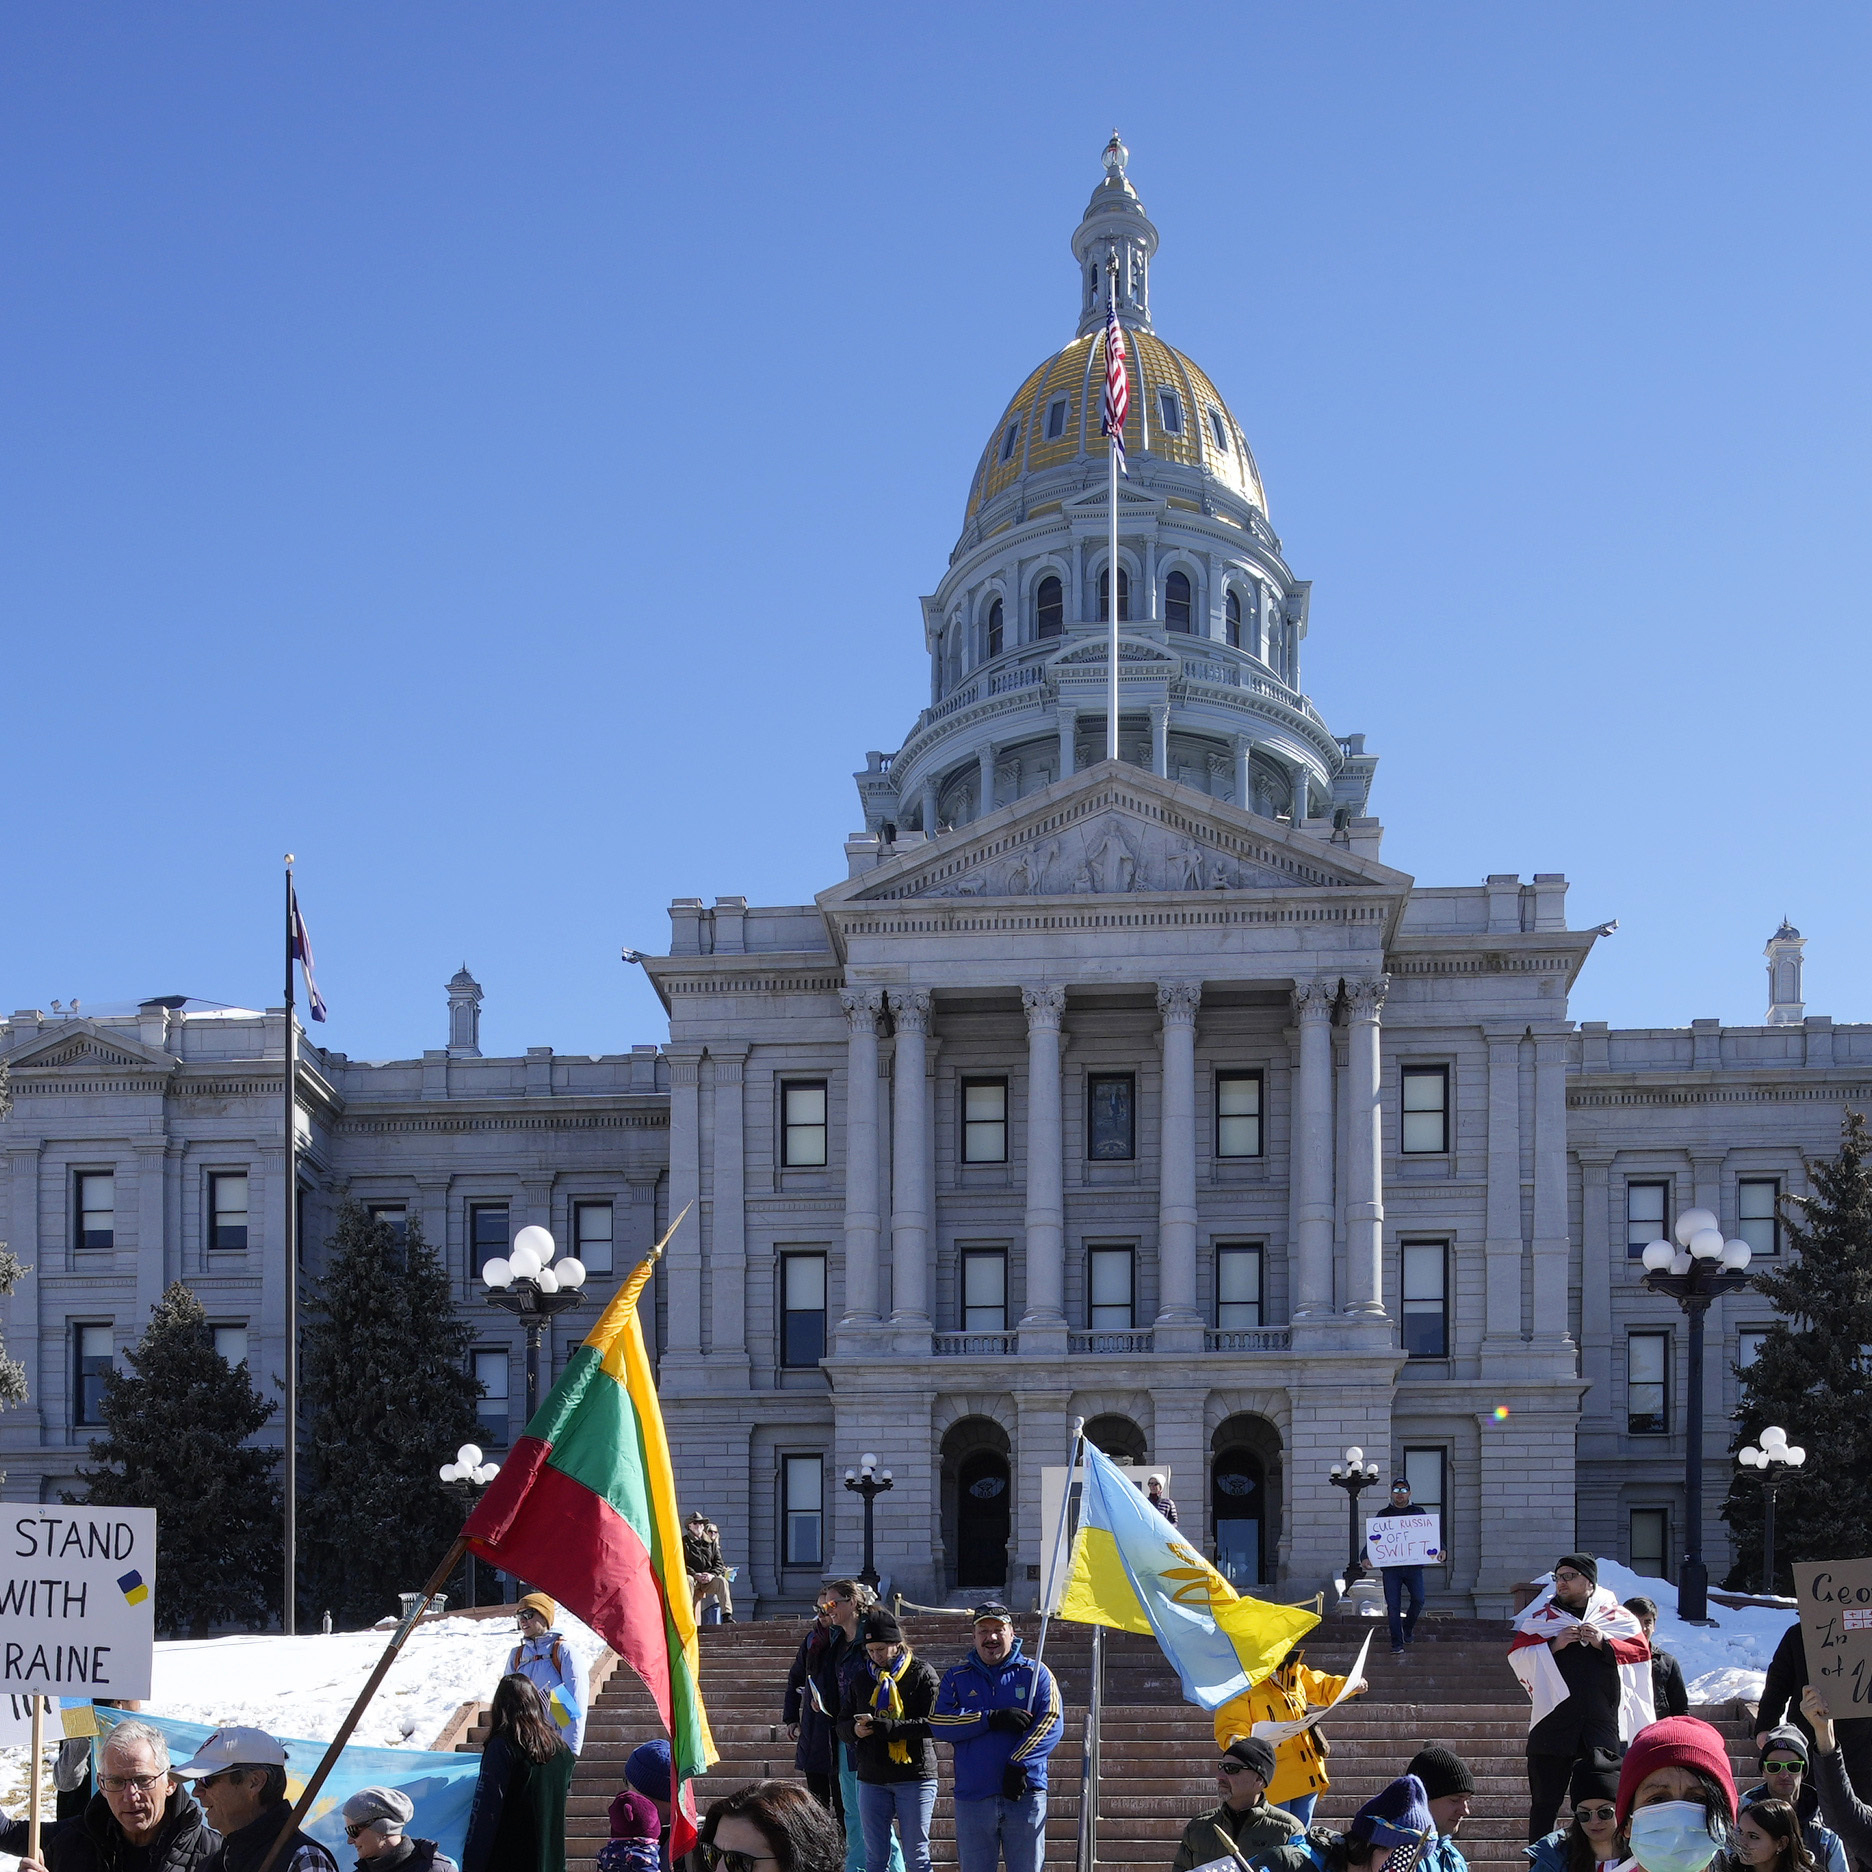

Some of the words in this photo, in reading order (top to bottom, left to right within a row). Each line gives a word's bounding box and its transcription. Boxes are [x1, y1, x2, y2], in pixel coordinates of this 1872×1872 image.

[1400, 1518, 1433, 1529] RUSSIA
[15, 1518, 135, 1561] STAND
[1386, 1531, 1409, 1543] OFF
[1376, 1541, 1431, 1560] SWIFT
[1816, 1618, 1849, 1649] In
[1821, 1655, 1845, 1677] of
